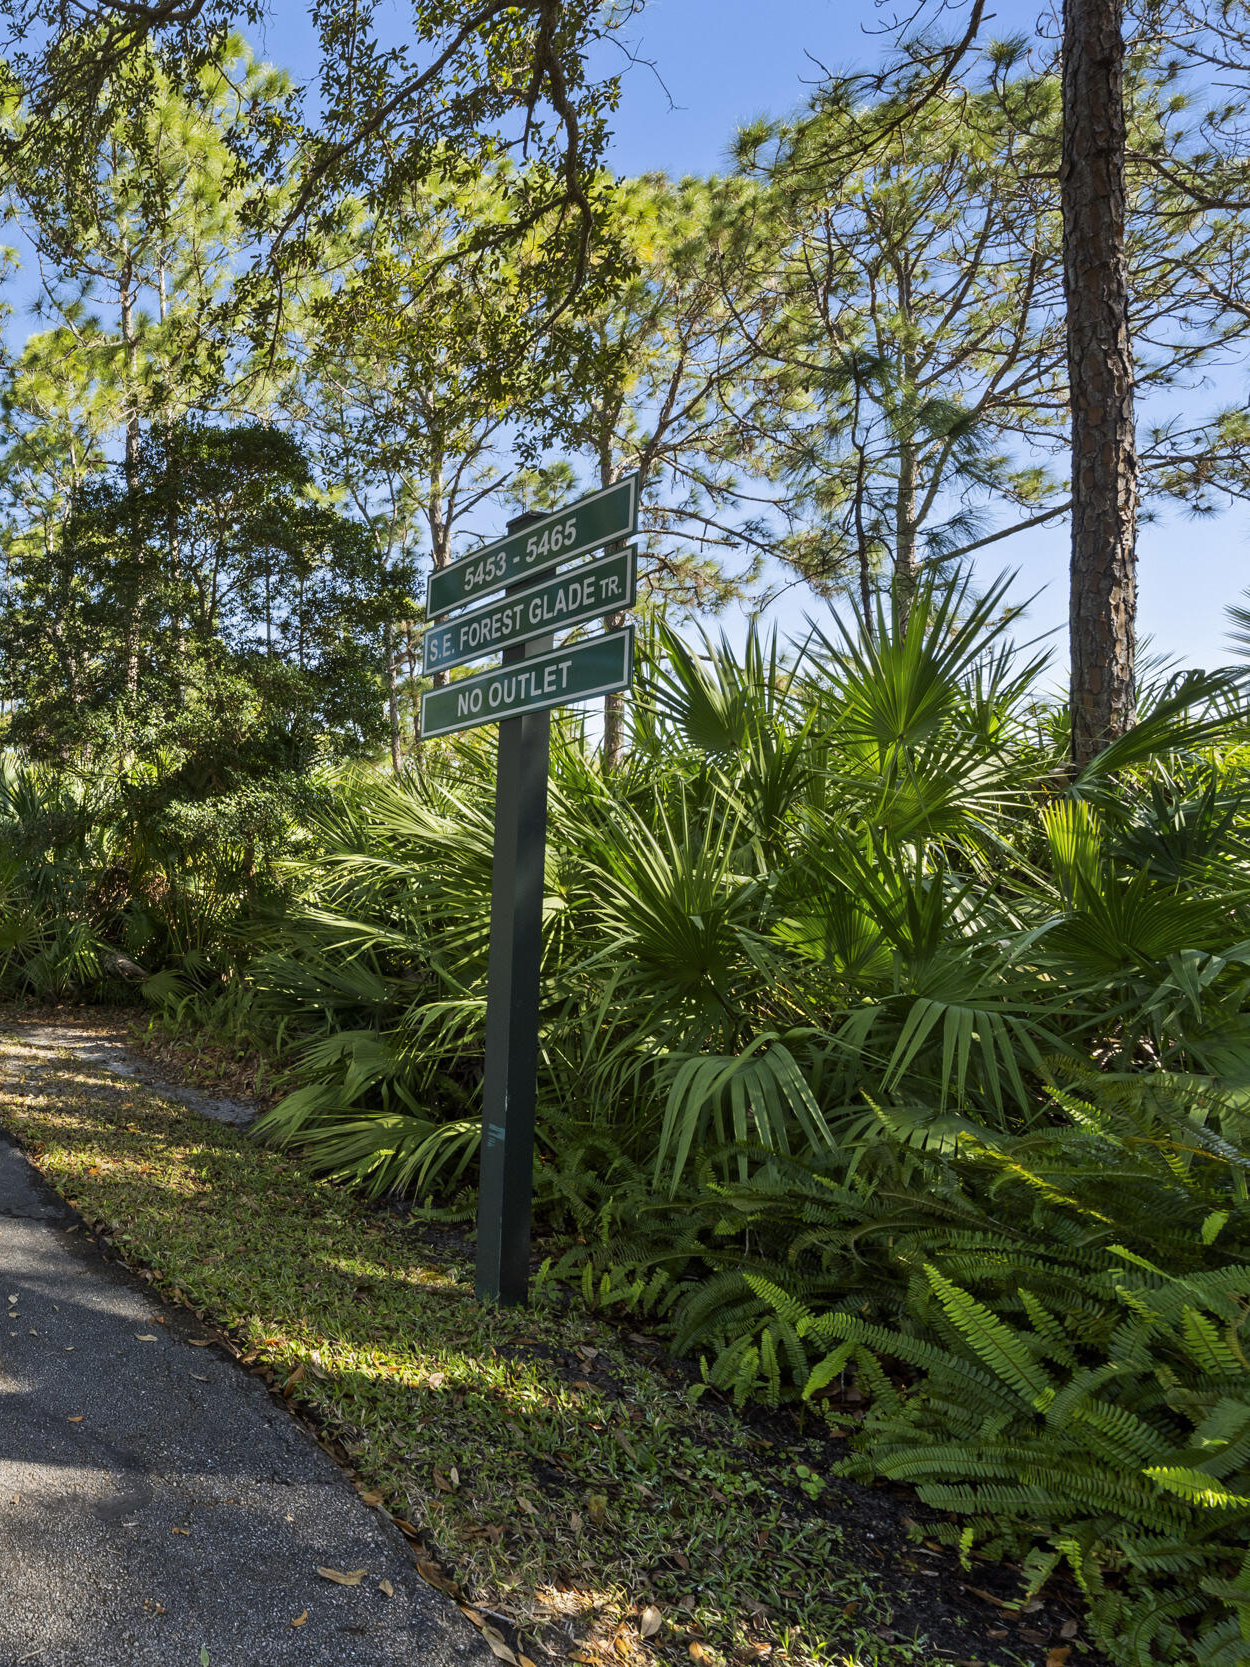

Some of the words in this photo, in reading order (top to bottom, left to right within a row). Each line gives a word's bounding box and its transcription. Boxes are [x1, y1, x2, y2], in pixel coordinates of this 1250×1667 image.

[464, 551, 507, 591] 5453
[512, 556, 520, 564] -
[526, 518, 577, 563] 5465
[429, 633, 455, 662] S.E.
[459, 604, 524, 652] FOREST
[528, 576, 596, 624] GLADE
[599, 575, 622, 599] TR.
[457, 688, 482, 717] NO
[488, 660, 572, 708] OUTLET
